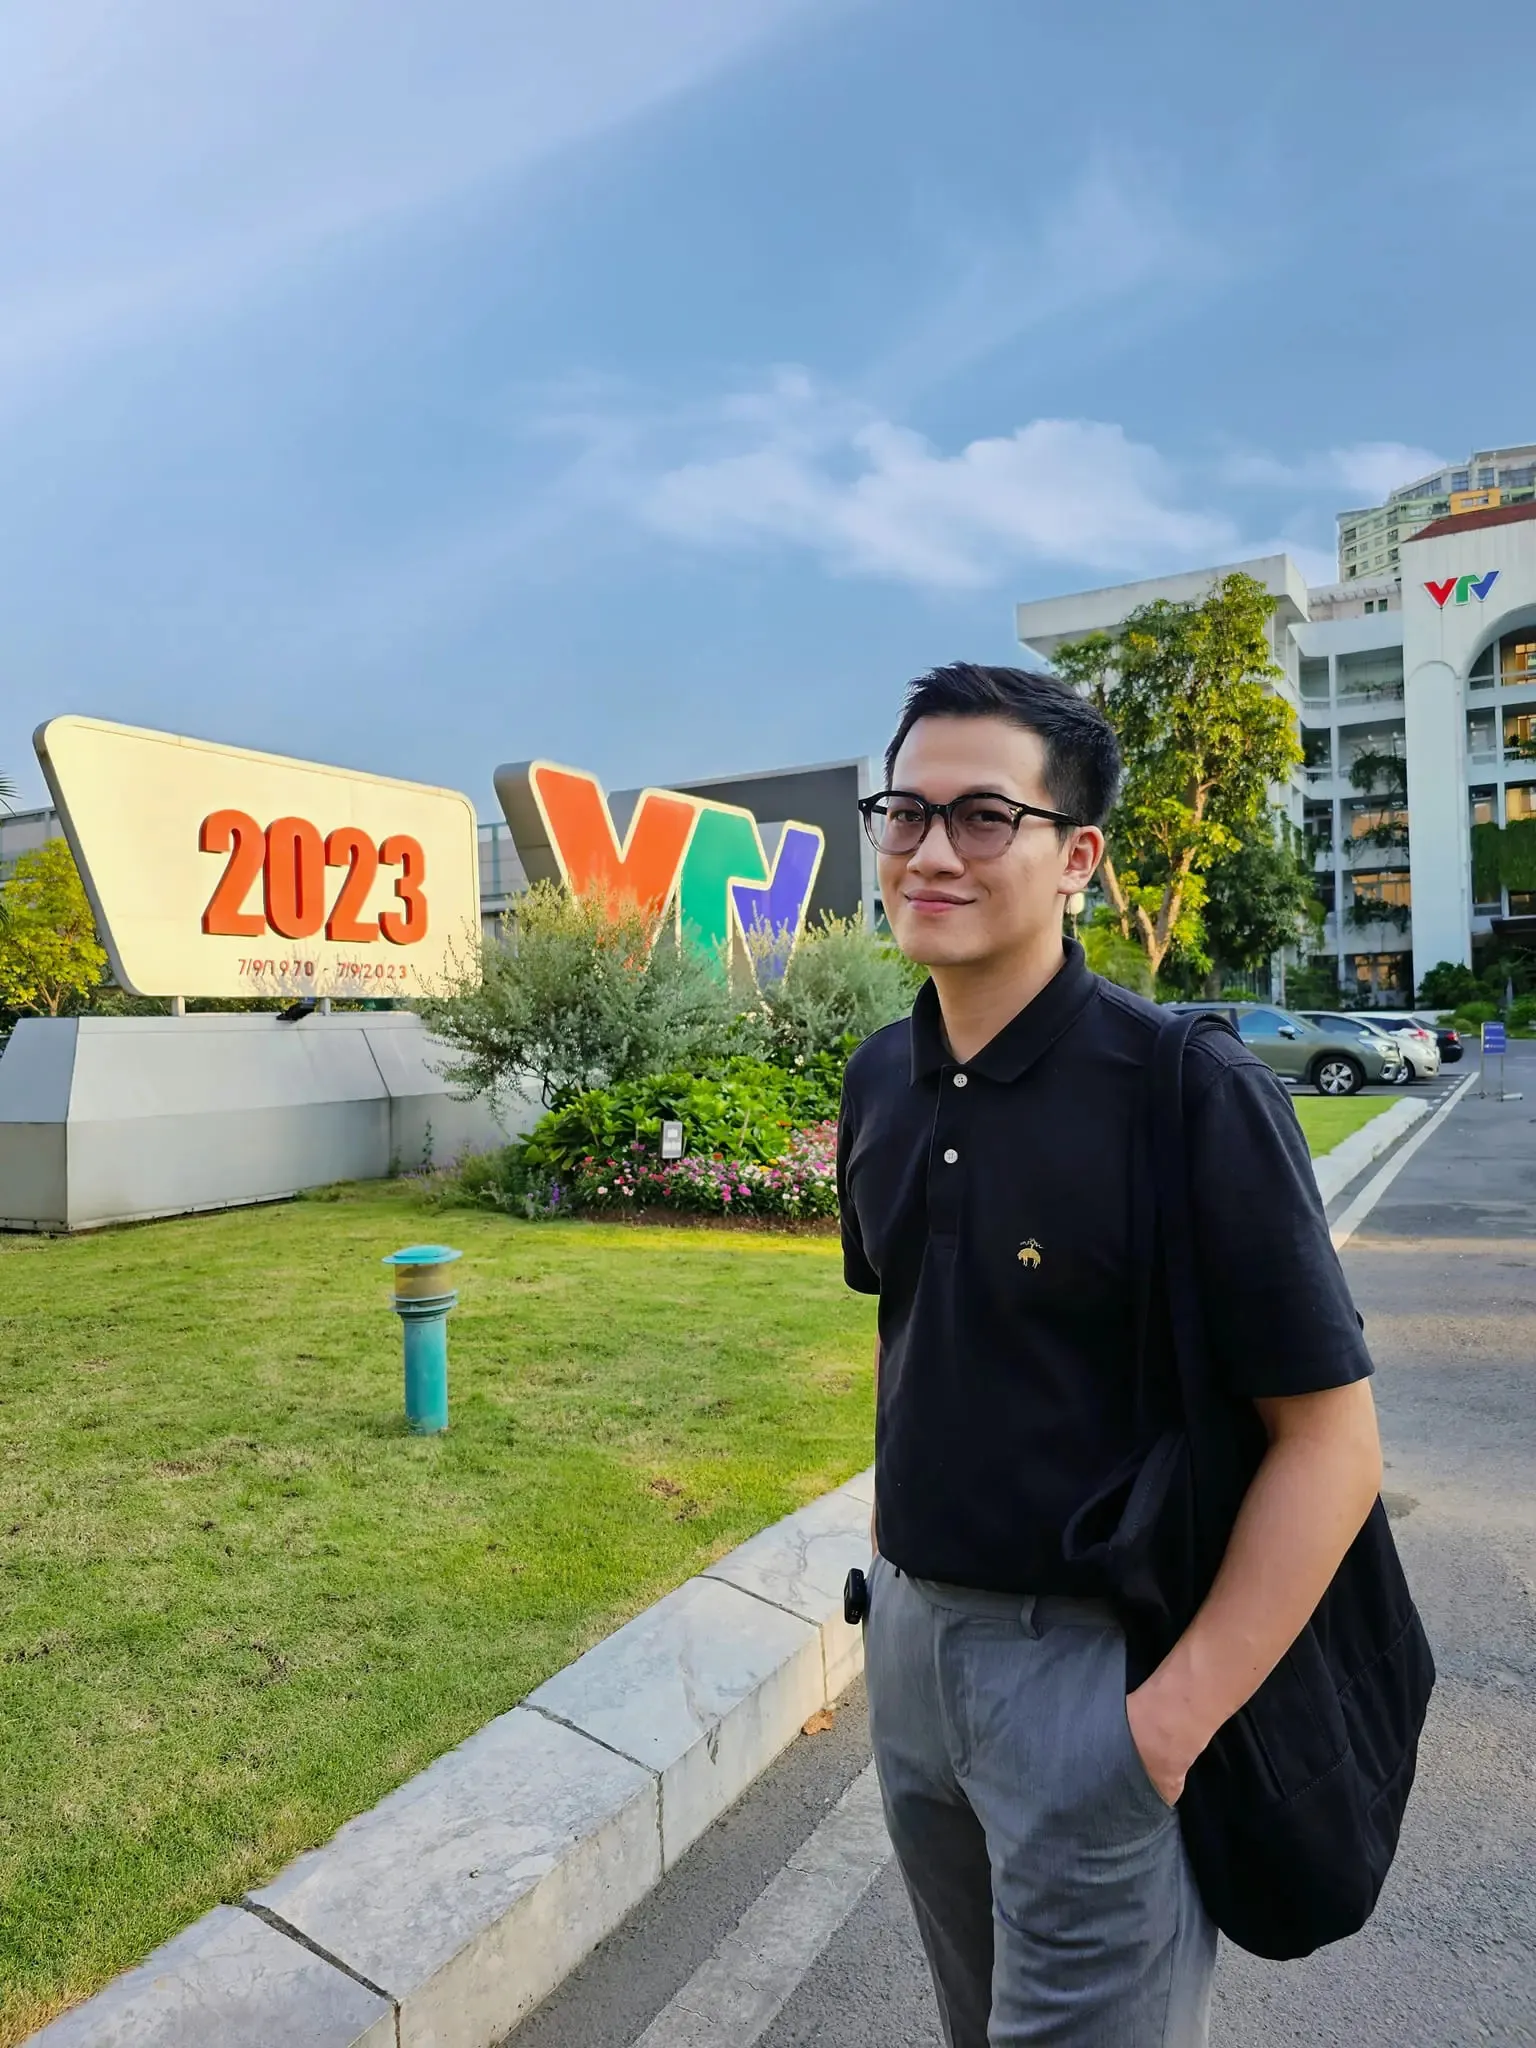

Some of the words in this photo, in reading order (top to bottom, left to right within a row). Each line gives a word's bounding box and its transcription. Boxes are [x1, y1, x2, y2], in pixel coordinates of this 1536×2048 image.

[1422, 570, 1500, 609] VTV
[200, 808, 428, 945] 2023
[528, 761, 825, 988] VTV
[237, 957, 315, 978] 7/9/1970
[337, 961, 408, 980] 7/9/2023
